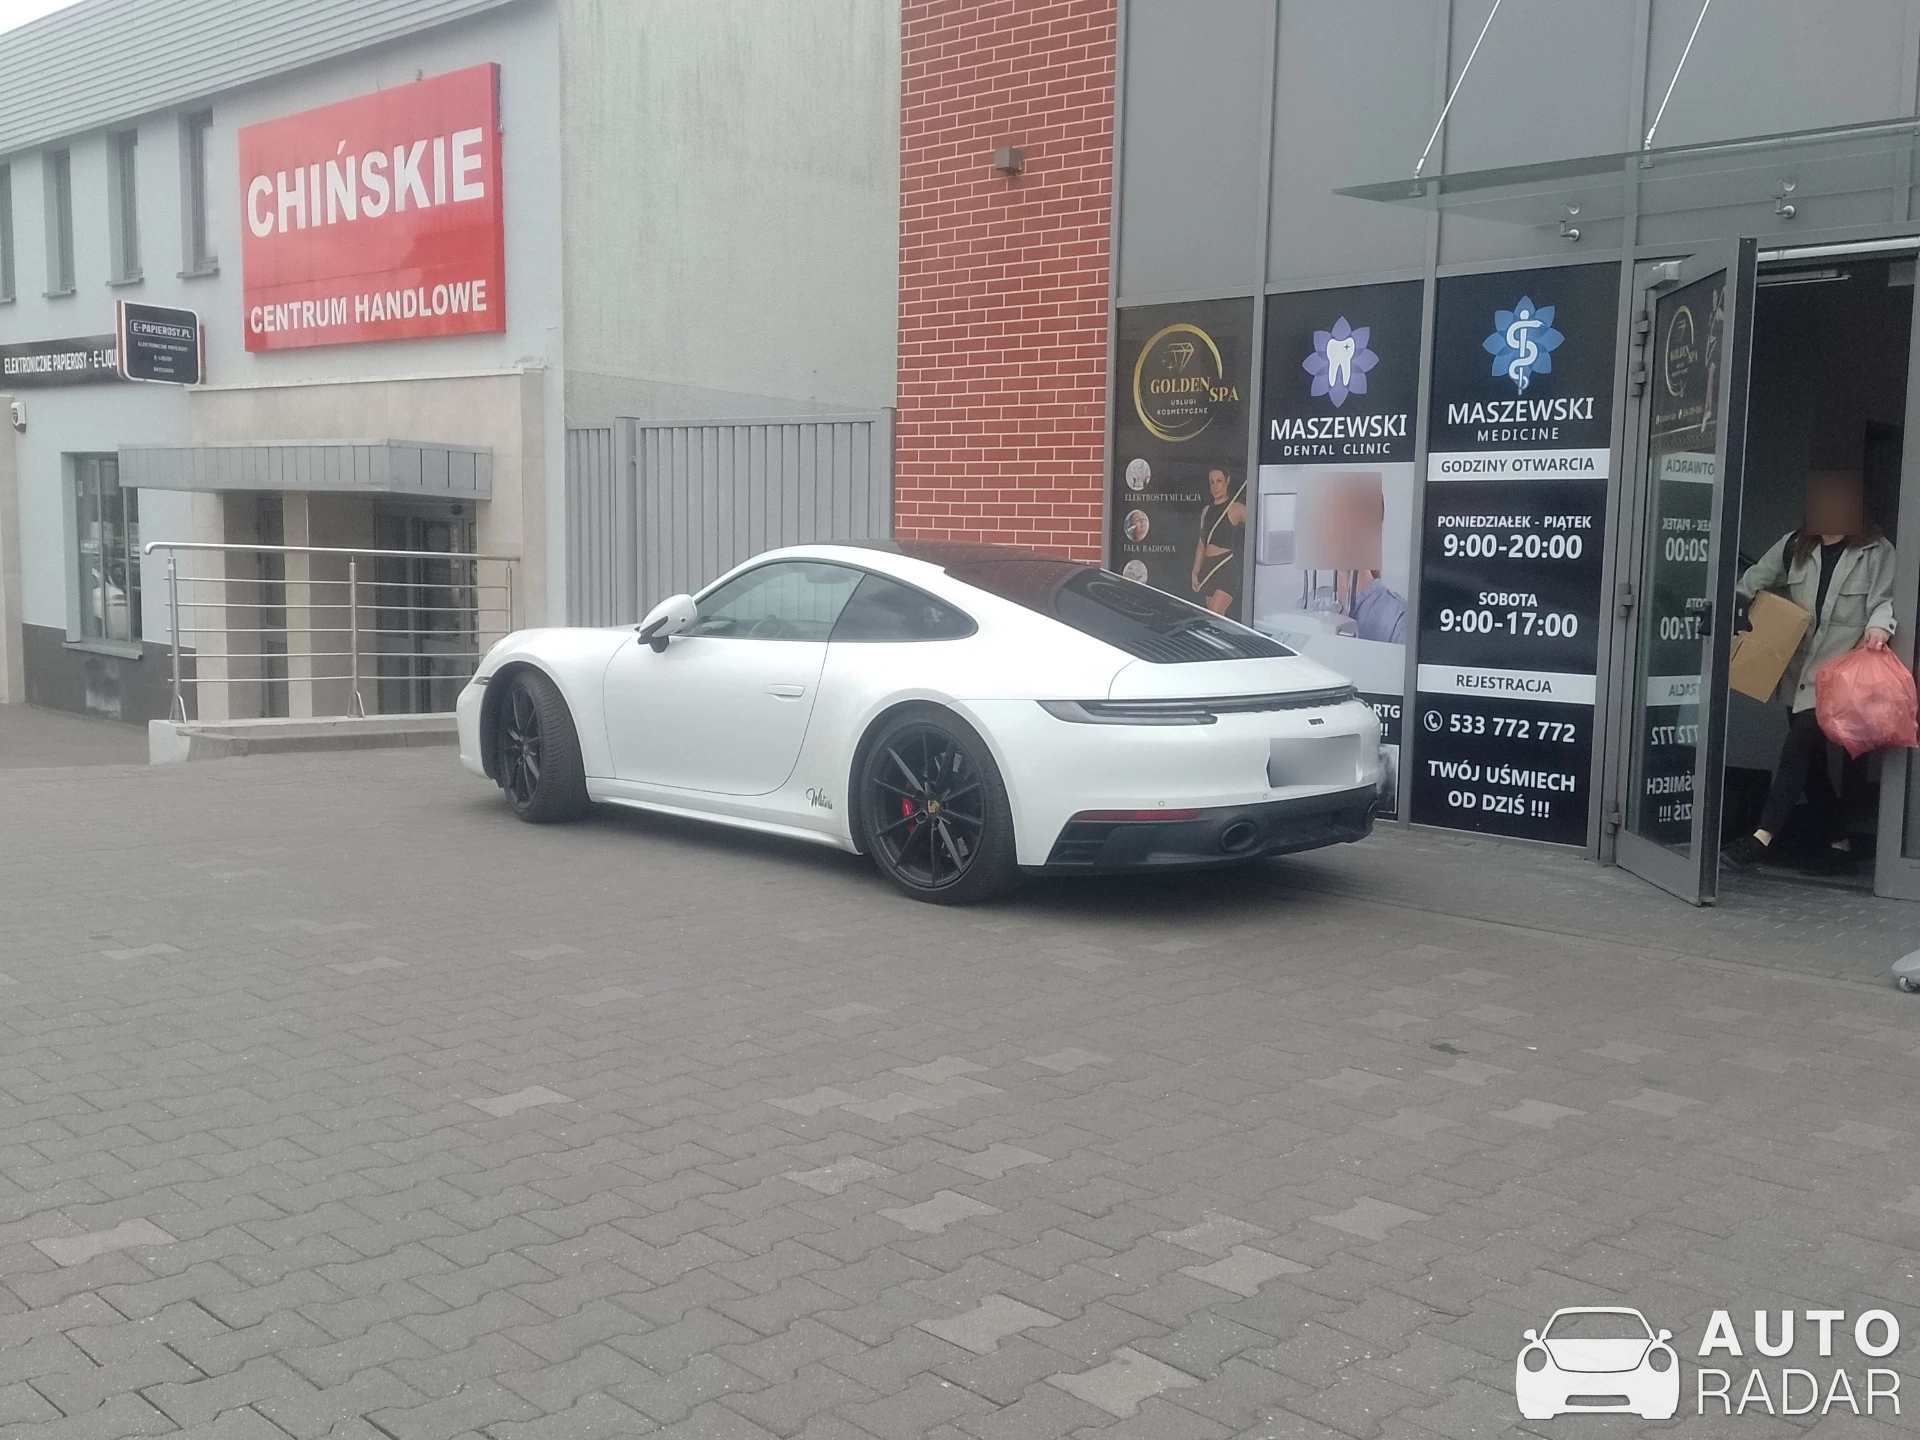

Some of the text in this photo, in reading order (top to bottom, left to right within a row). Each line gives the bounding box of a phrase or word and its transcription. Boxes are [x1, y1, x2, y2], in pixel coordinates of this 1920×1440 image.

[247, 126, 485, 238] CHIŃSKIE
[250, 279, 487, 334] CENTRUM HANDLOWE
[133, 322, 191, 338] E-PAPIEROSY.PL
[4, 354, 52, 374] ELEKTRONICZNE
[53, 351, 87, 371] PAPIEROSY
[93, 348, 117, 368] E-LIQU
[1150, 376, 1239, 403] GOLDEN SPA
[1156, 407, 1208, 416] KOSMETYCZNE
[1447, 397, 1594, 425] MASZEWSKI
[1270, 414, 1408, 441] MASZEWSKI
[1477, 426, 1560, 442] MEDICINE
[1283, 442, 1391, 456] DENTAL CLINIC
[1441, 457, 1595, 473] GODZINY OTWARCIA
[1124, 493, 1202, 502] ELEKTROSTYMULACJA
[1437, 515, 1532, 529] PONIEDZIAŁEK
[1543, 515, 1593, 532] PIĄTEK
[1123, 544, 1176, 553] FALA RADIOWA
[1443, 533, 1583, 560] 9:00-20:00
[1478, 591, 1539, 607] SOBOTA
[1439, 608, 1578, 638] 9:00-17:00
[1456, 674, 1552, 694] REJESTRACJA
[1373, 703, 1401, 719] RTG
[1449, 713, 1576, 743] 533 772 772
[1427, 759, 1576, 793] TWÓJ UŚMIECH
[1447, 790, 1550, 818] OD DZIŚ !!!
